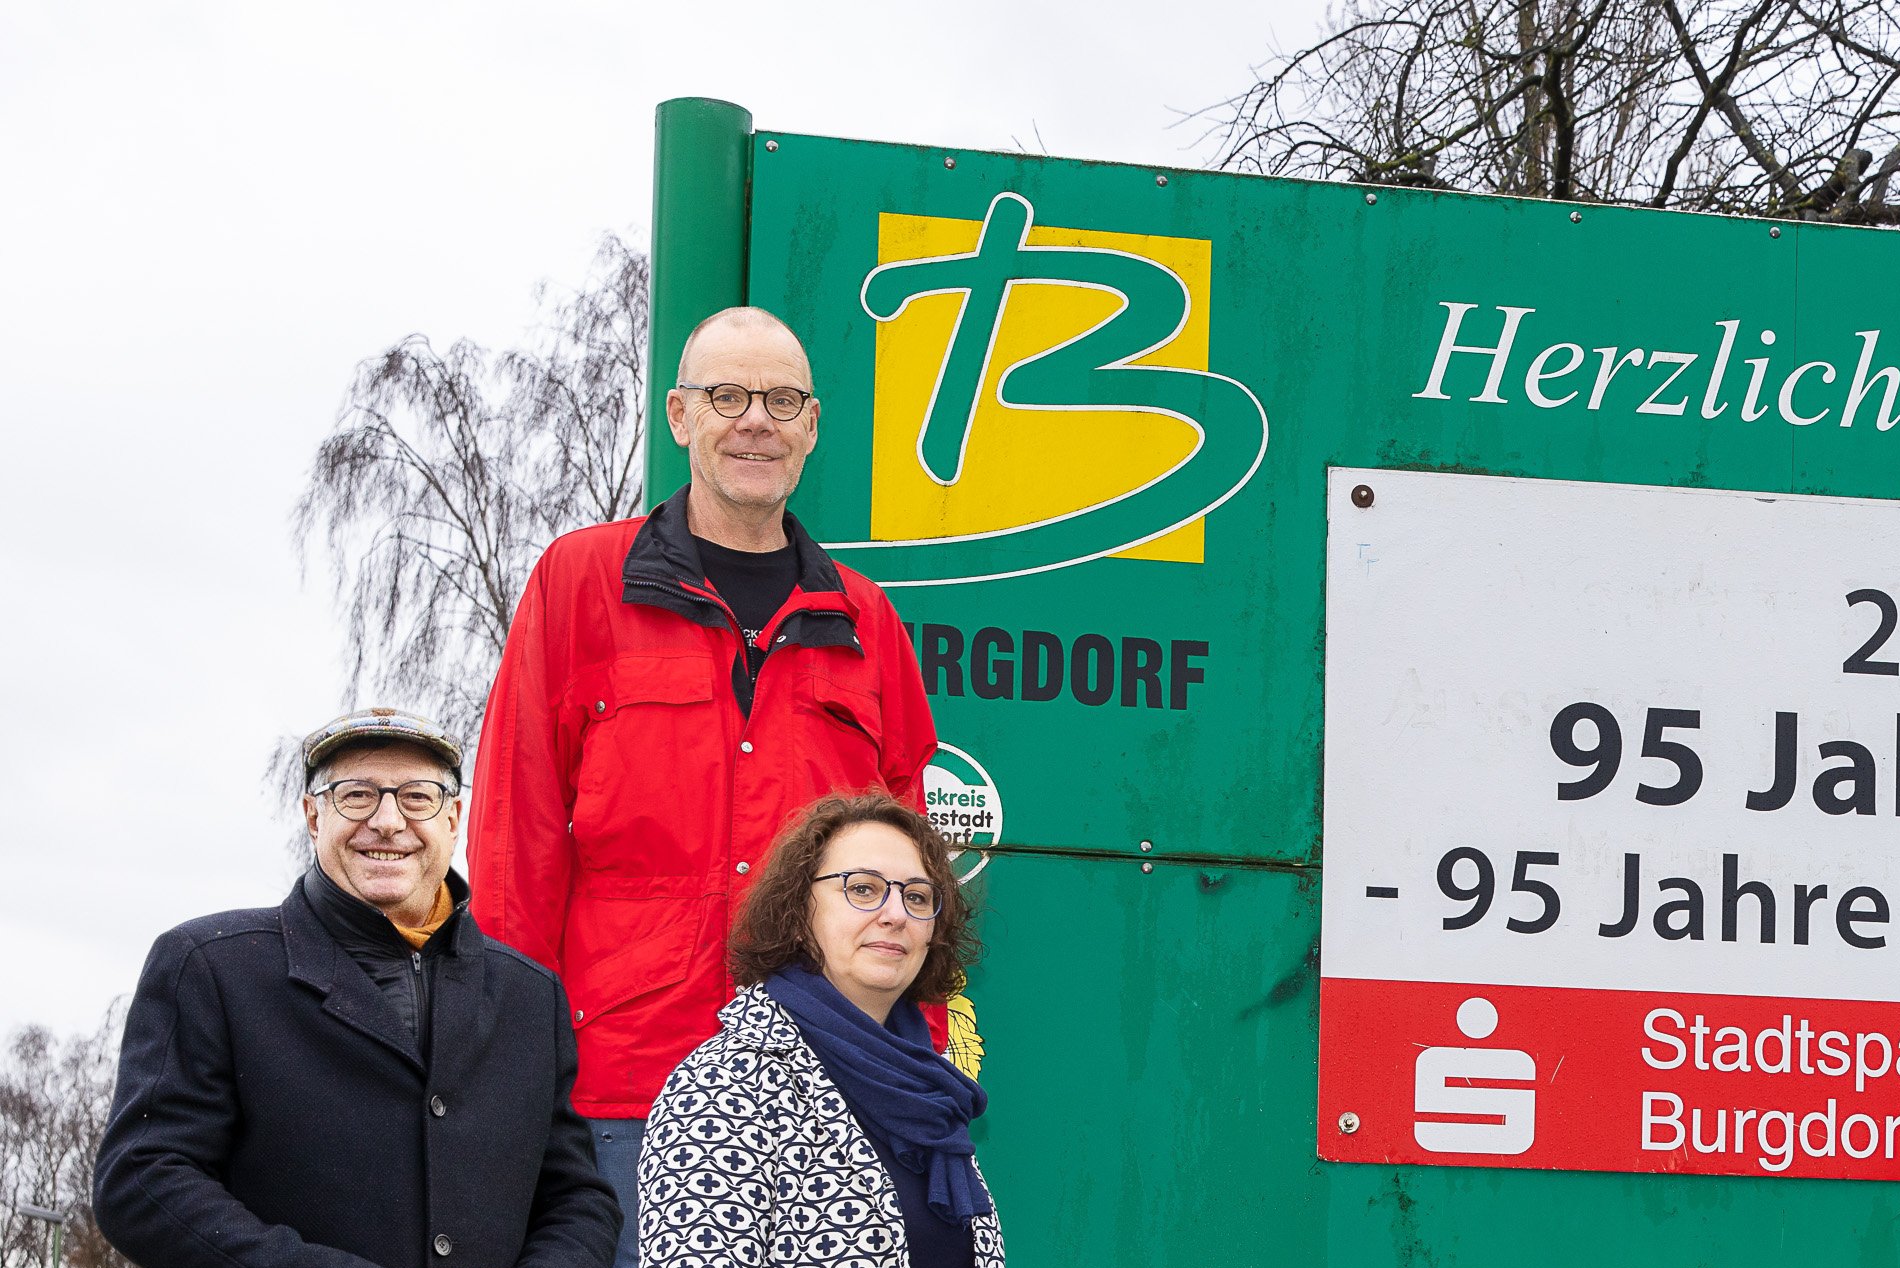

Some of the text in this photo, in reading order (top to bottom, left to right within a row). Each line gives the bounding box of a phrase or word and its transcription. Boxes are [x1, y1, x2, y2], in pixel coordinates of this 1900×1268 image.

[901, 621, 1210, 711] RGDORF
[1549, 701, 1704, 807] 95
[935, 827, 973, 845] orf
[1365, 885, 1399, 899] -
[1436, 846, 1561, 935] 95
[1598, 852, 1890, 950] Jahre
